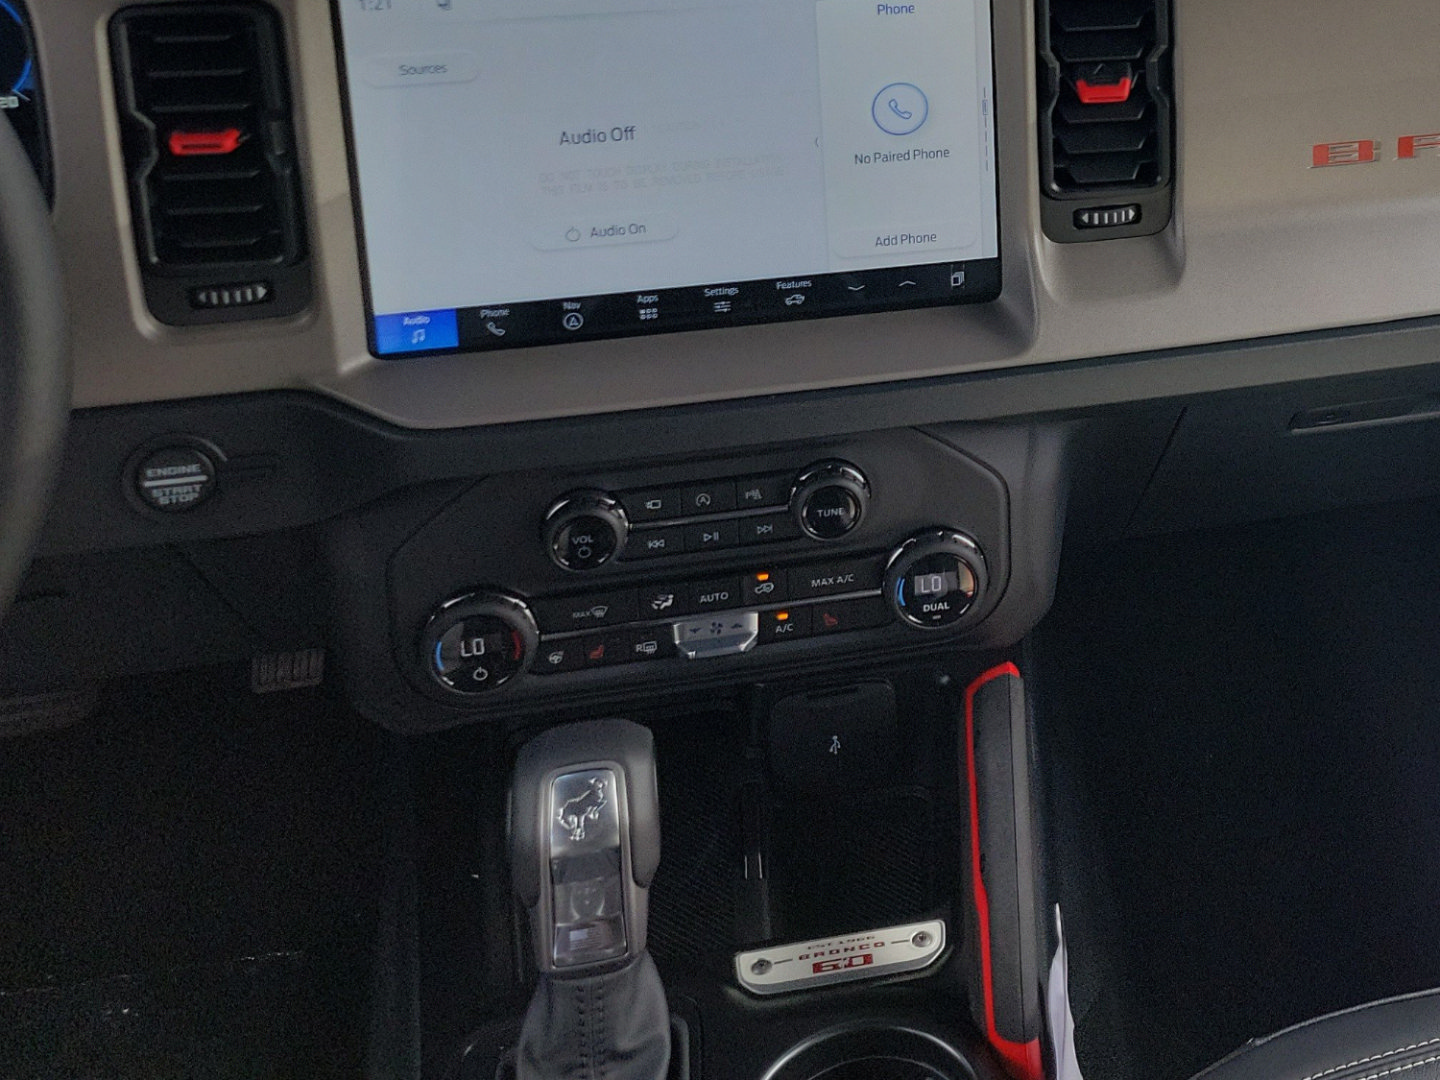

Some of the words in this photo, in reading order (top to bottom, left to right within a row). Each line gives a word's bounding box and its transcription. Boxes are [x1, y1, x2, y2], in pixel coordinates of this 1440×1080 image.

[877, 3, 916, 16] Phone
[398, 64, 448, 76] Sources
[559, 128, 607, 146] Audio
[610, 125, 637, 142] Off
[854, 153, 871, 165] No
[873, 149, 911, 163] Paired
[913, 147, 951, 160] Phone
[590, 224, 626, 238] Audio
[628, 223, 647, 235] On
[875, 234, 898, 247] Add
[900, 233, 937, 245] Phone
[776, 279, 812, 291] Features
[704, 286, 739, 297] Settings
[562, 300, 582, 311] Nav
[637, 294, 659, 306] Apps
[480, 307, 511, 319] Phone
[403, 315, 431, 327] Audio
[146, 464, 201, 478] ENGINE
[152, 484, 202, 498] START
[159, 492, 199, 505] STOP
[817, 507, 845, 518] TUNE
[572, 534, 594, 545] VOL
[811, 577, 834, 588] MAX
[836, 573, 855, 584] A/C
[700, 591, 729, 604] AUTO
[923, 602, 950, 613] DUAL
[775, 624, 794, 634] A/C
[799, 941, 885, 960] BRONCO
